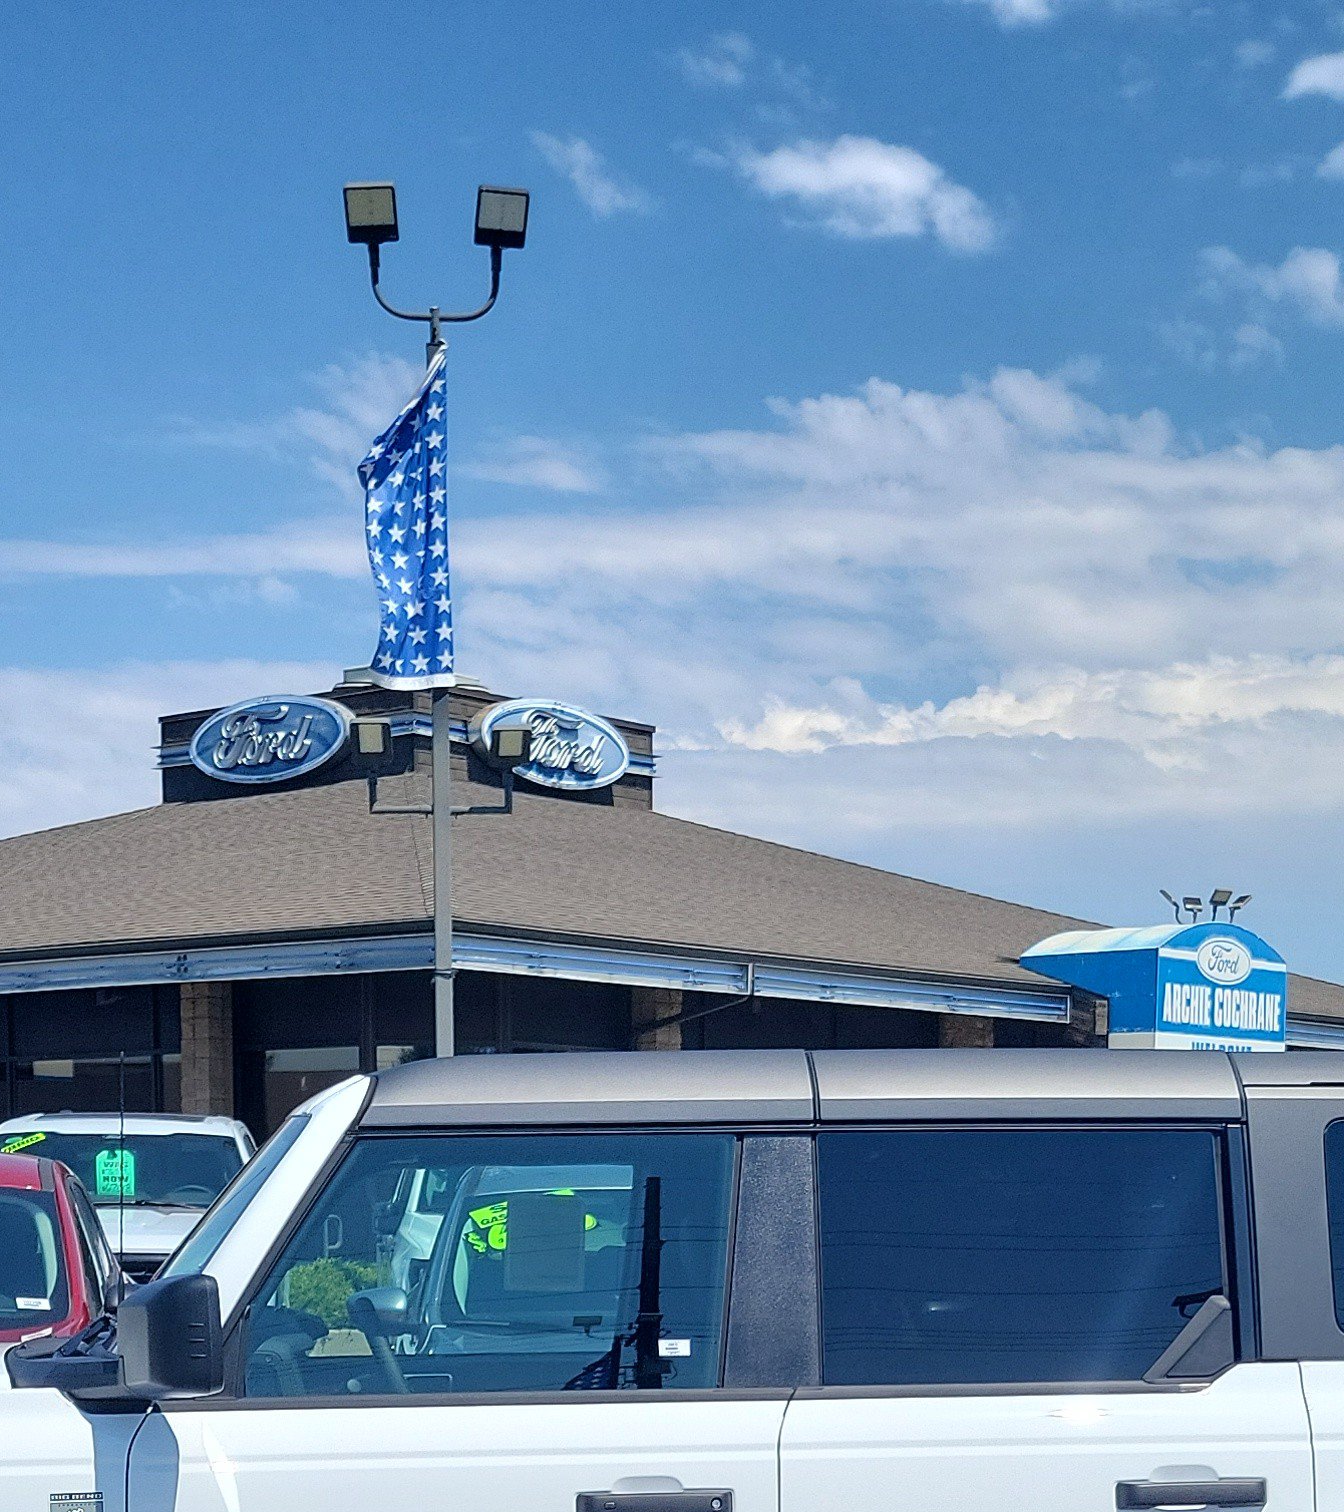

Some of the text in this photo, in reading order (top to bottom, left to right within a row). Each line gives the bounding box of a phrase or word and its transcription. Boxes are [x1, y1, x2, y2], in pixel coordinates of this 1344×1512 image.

[213, 704, 314, 770] Ford
[527, 708, 606, 776] Ford
[1207, 944, 1240, 975] Ford
[1162, 982, 1281, 1032] ARCHIE COCHRANE
